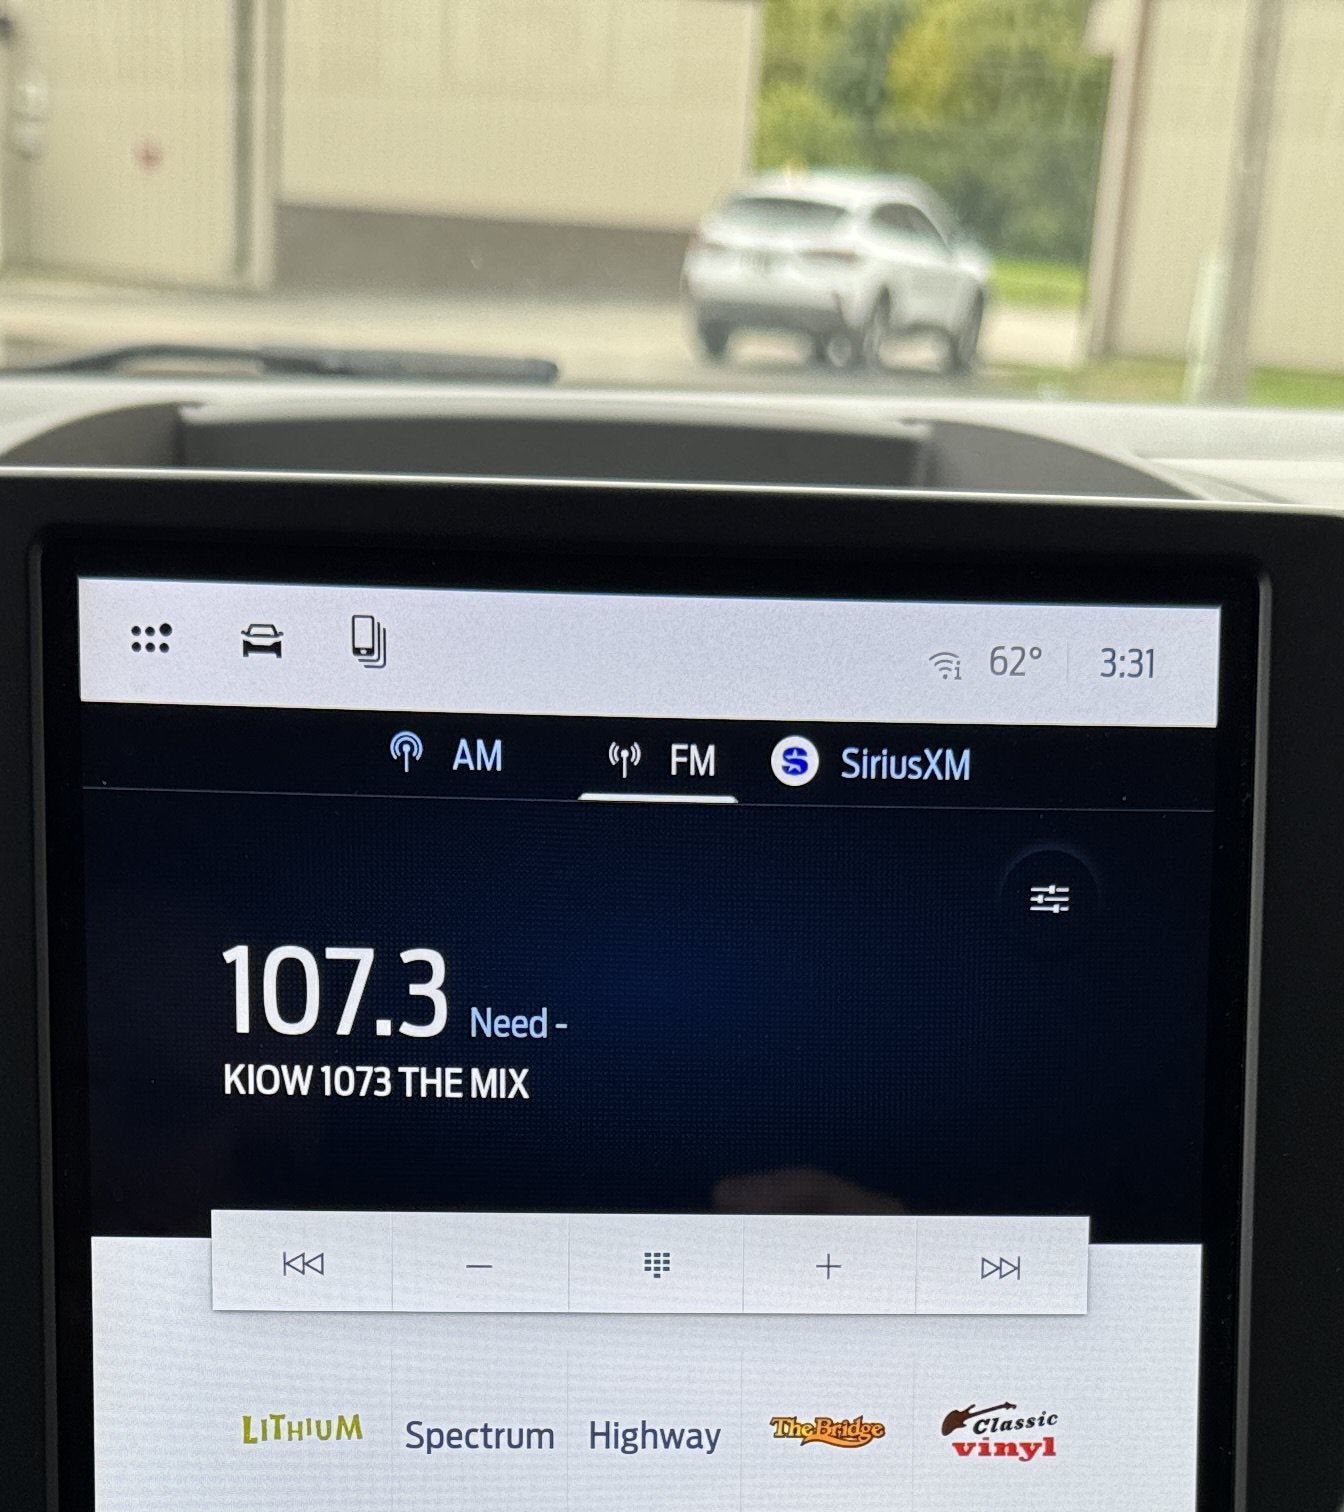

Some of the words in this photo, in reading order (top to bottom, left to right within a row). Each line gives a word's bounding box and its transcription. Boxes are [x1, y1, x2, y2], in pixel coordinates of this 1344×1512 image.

[990, 646, 1041, 676] 62°
[1101, 648, 1153, 678] 3:31
[453, 739, 501, 771] AM
[671, 744, 715, 776] FM
[842, 747, 970, 780] SiriusXM
[223, 945, 447, 1037] 107.3
[471, 1007, 547, 1038] Need
[225, 1064, 313, 1095] KIOW
[321, 1066, 391, 1096] 1073
[398, 1067, 463, 1098] THE
[471, 1068, 529, 1098] MIX
[243, 1414, 362, 1444] LITHIUM
[406, 1421, 553, 1454] Spectrum
[591, 1420, 721, 1454] Highway
[973, 1411, 1058, 1435] Classic
[951, 1436, 1057, 1462] vinyl
